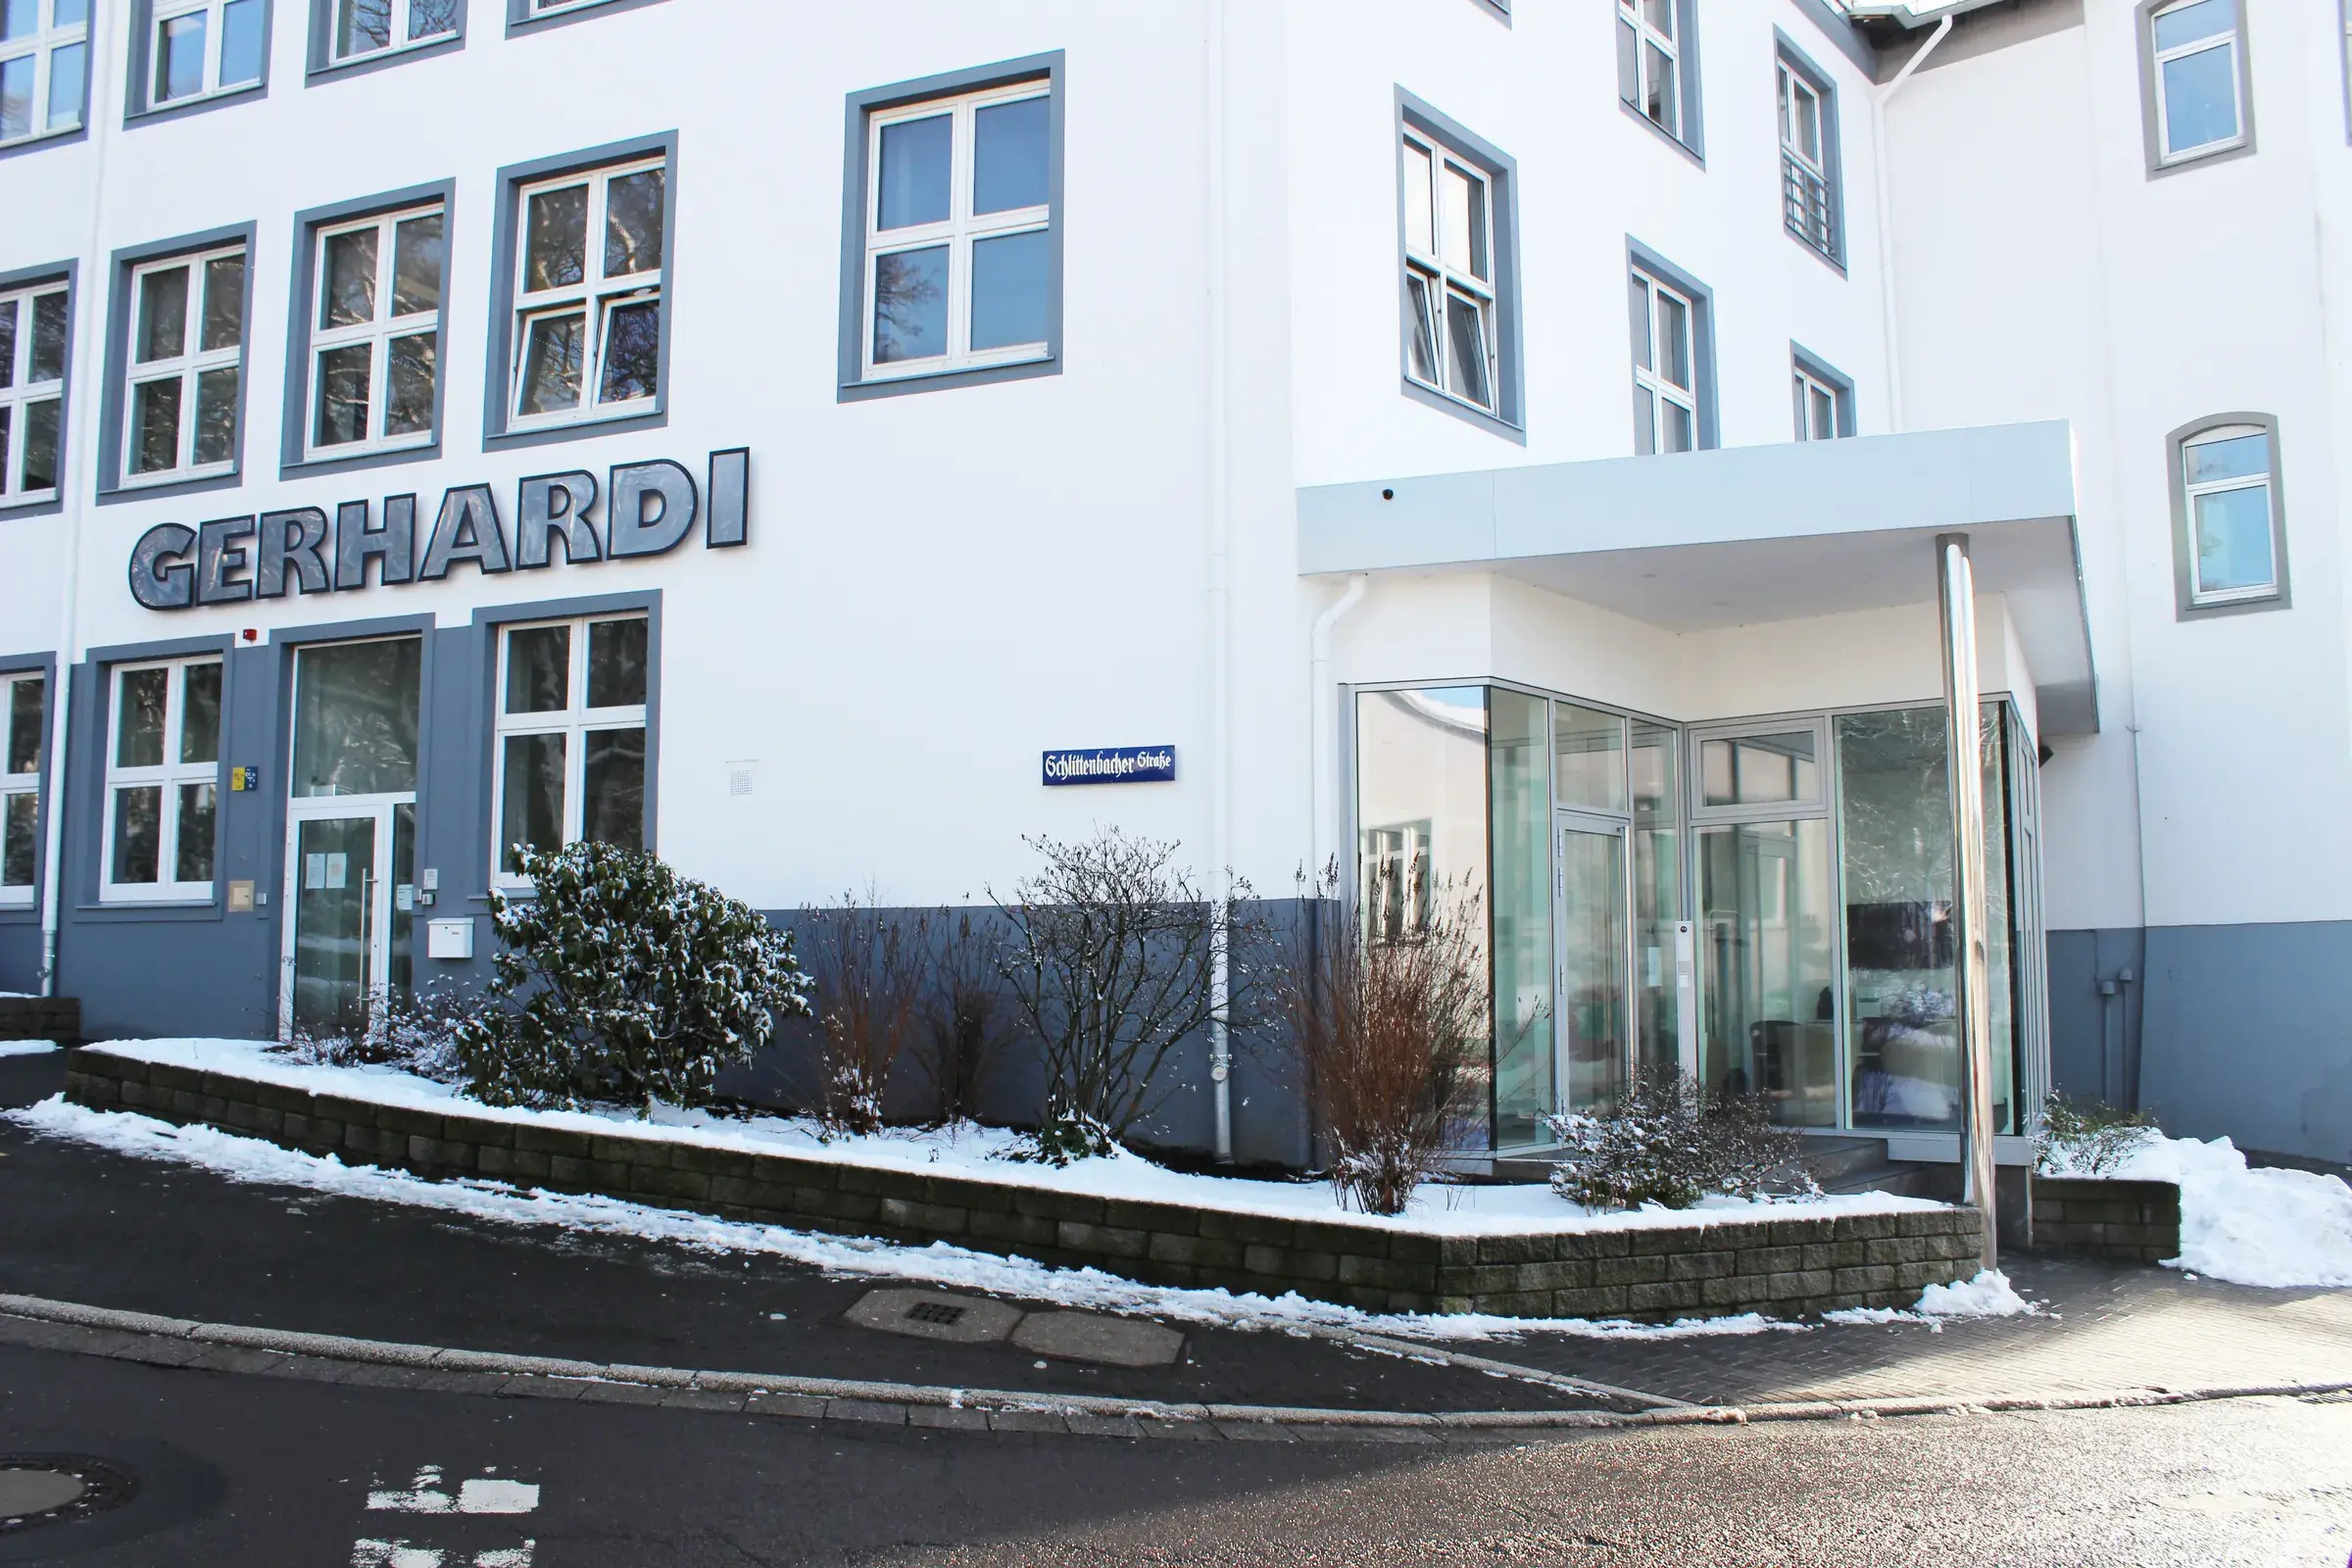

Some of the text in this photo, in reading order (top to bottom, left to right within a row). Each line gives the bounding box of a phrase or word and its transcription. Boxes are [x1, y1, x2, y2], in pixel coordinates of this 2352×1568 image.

[128, 446, 751, 612] GERHARDI
[1045, 751, 1171, 781] Schlittenbacher Straße
